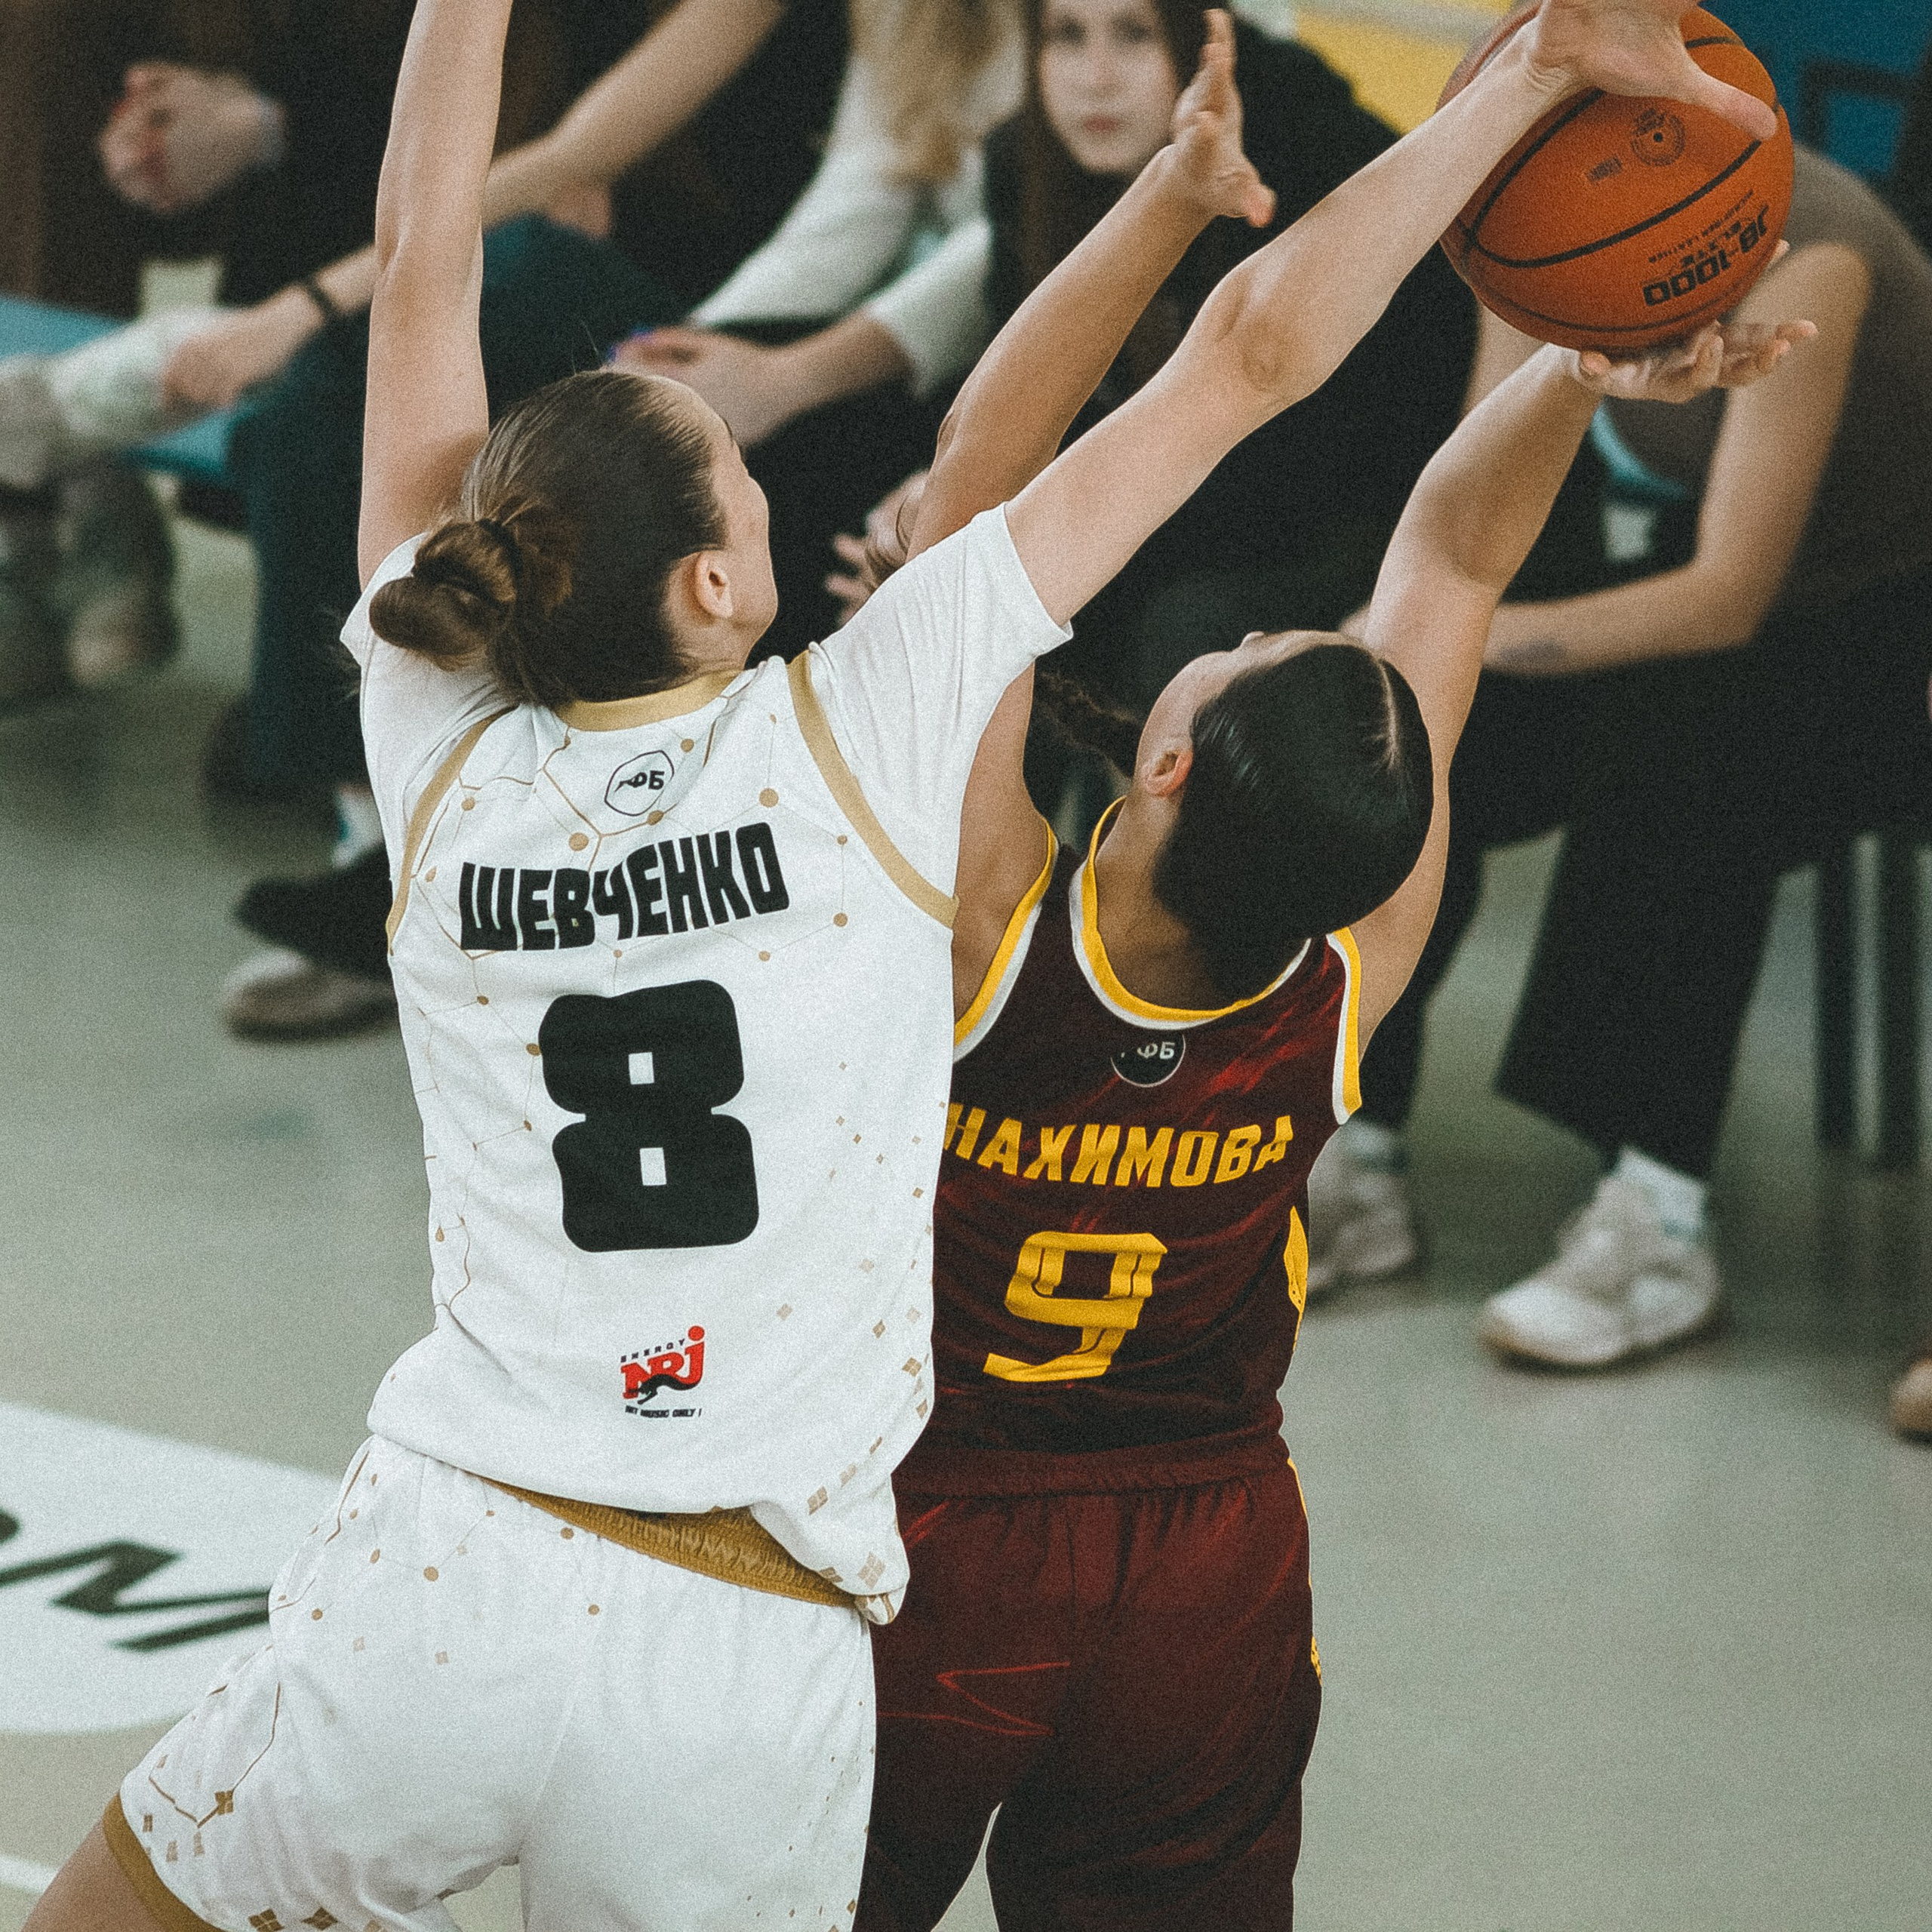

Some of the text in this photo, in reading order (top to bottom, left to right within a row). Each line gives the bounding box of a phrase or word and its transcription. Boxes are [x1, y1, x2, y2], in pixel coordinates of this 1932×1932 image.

[1642, 202, 1769, 306] JB-1000
[459, 822, 790, 951] ШЕВЧЕНКО
[538, 980, 759, 1253] 8
[943, 1103, 1294, 1187] НАХИМОВА
[983, 1231, 1168, 1383] 9
